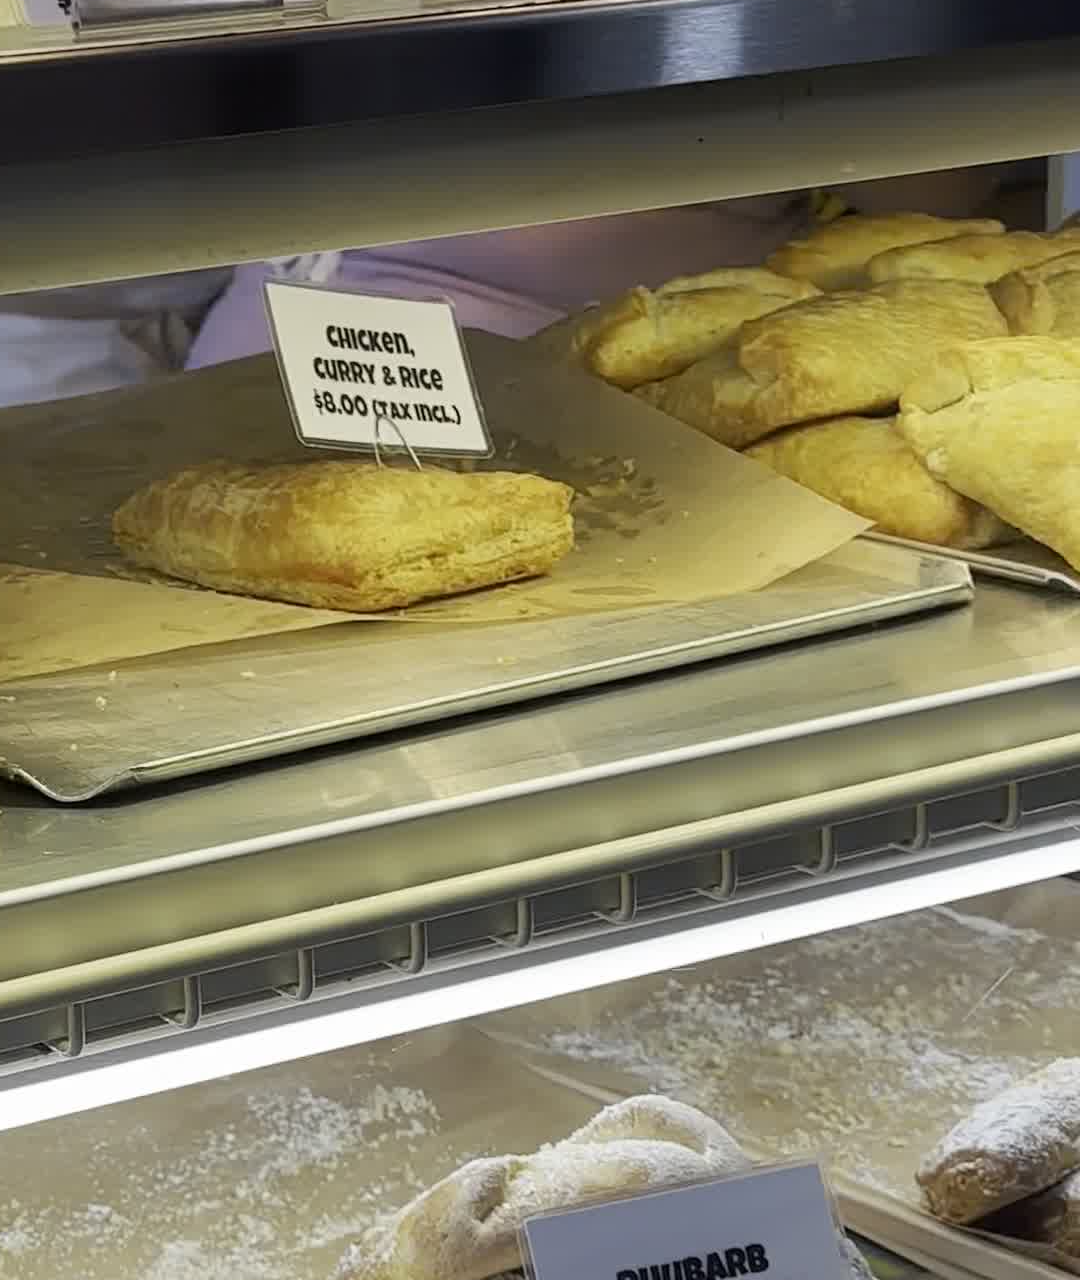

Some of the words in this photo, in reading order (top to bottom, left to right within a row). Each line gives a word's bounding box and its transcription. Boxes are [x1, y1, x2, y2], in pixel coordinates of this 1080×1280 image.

[313, 356, 377, 386] CURRY
[382, 365, 397, 387] &
[313, 388, 369, 417] $8.00
[373, 399, 413, 421] (TAX
